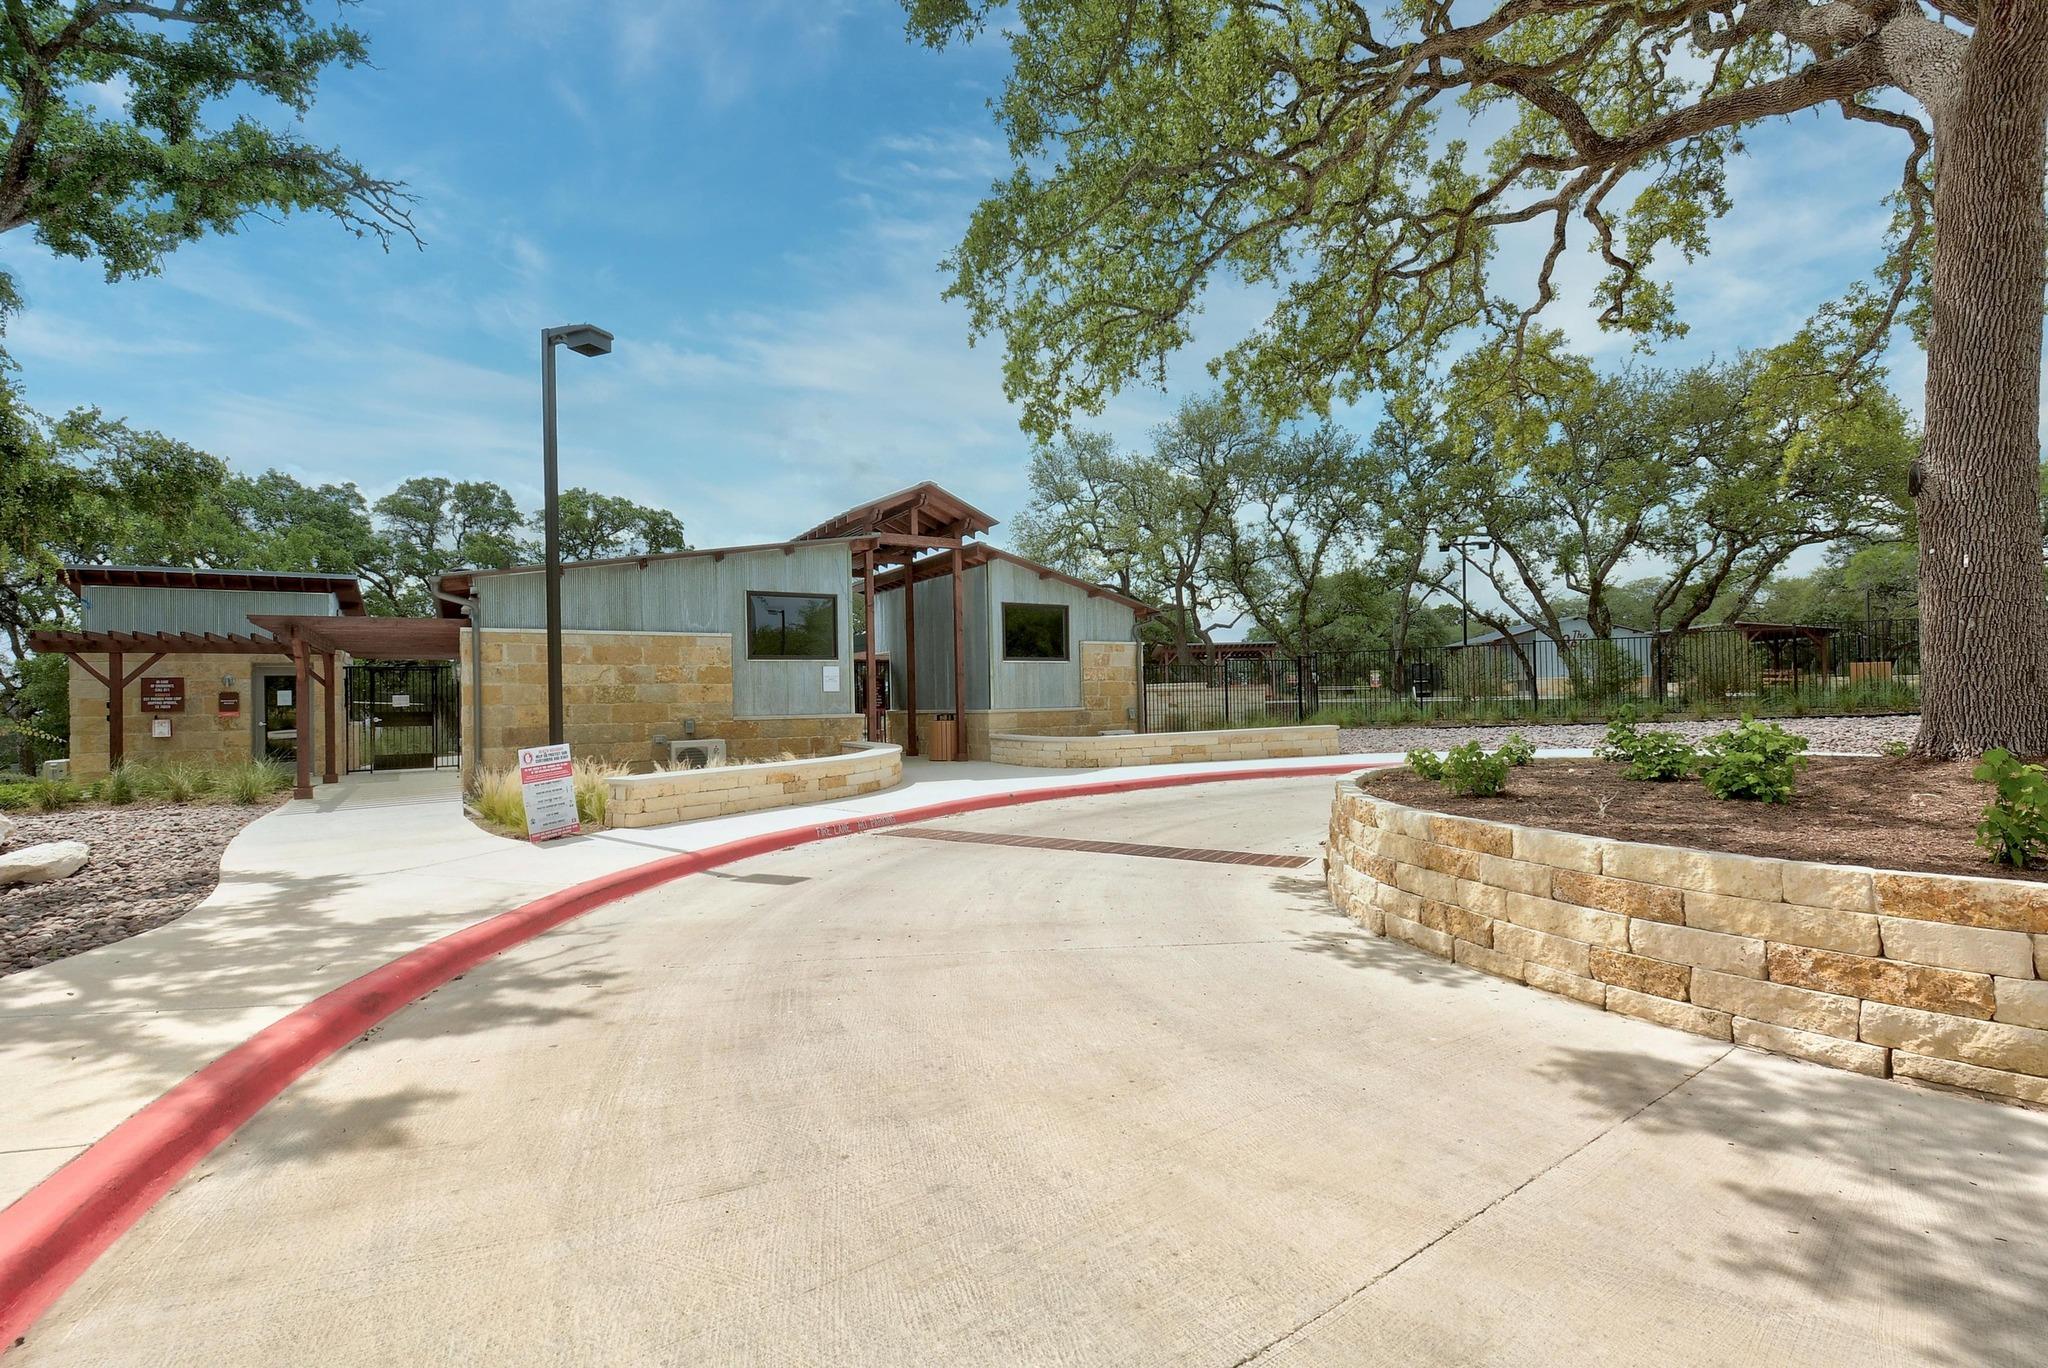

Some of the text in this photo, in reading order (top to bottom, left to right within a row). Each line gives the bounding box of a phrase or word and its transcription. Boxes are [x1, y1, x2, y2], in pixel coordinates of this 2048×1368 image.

[815, 814, 896, 838] FIRE LANE NO PARKING
